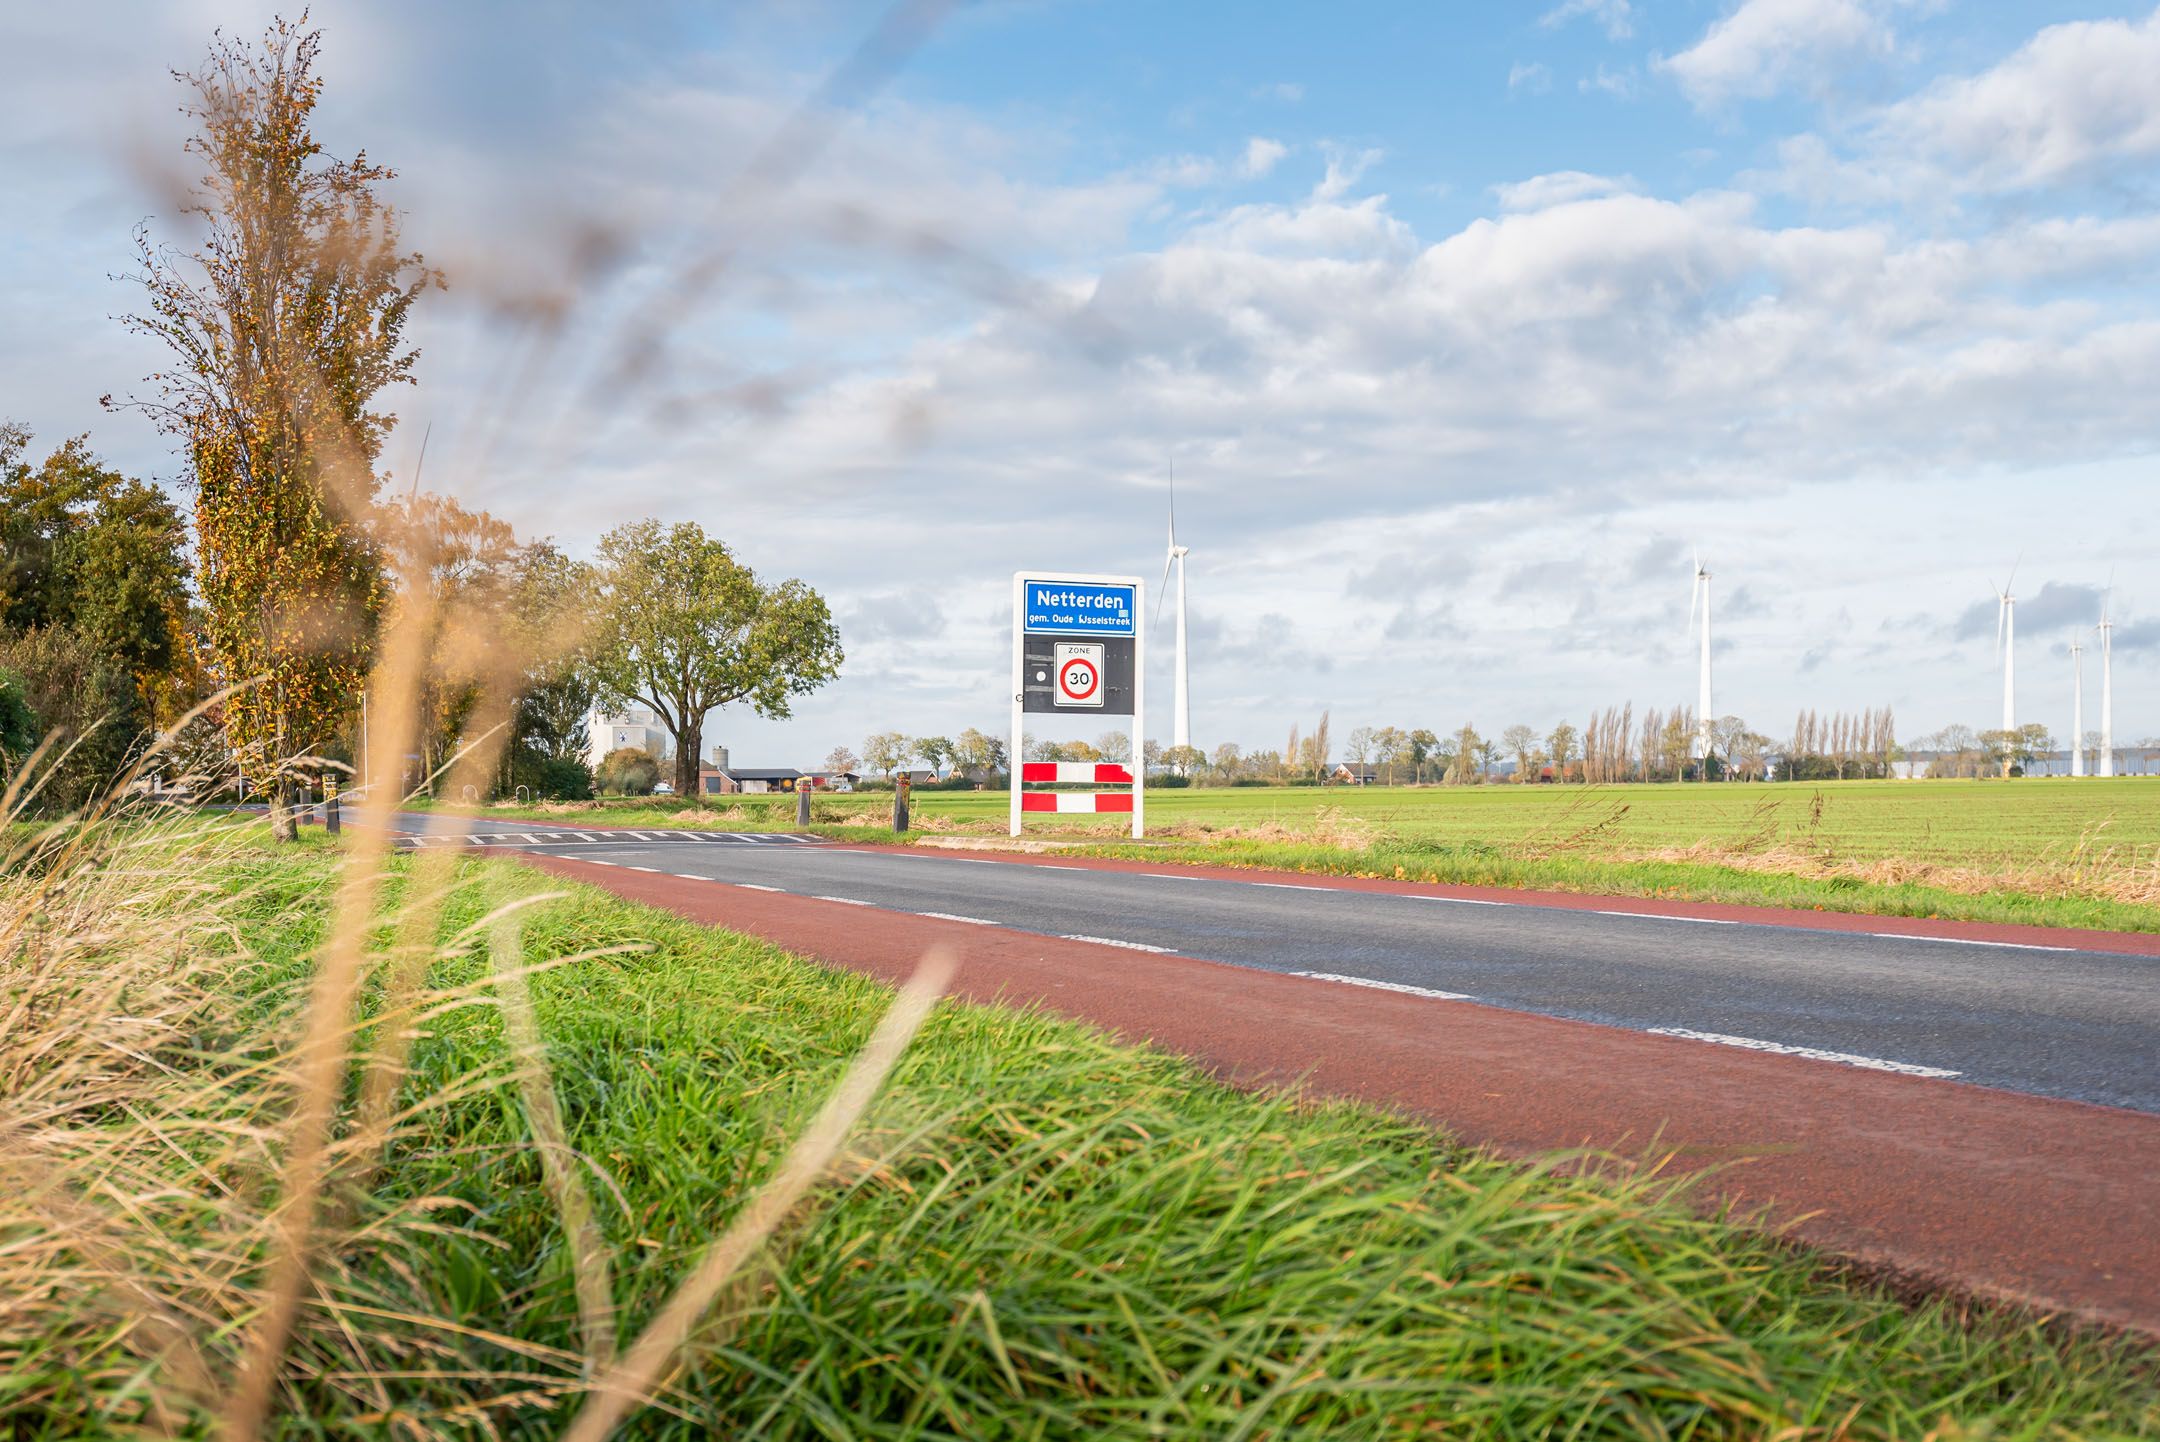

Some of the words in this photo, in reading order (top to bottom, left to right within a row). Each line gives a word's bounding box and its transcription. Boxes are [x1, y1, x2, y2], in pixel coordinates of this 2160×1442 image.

[1037, 590, 1123, 609] Netterden
[1029, 614, 1049, 624] gem.
[1052, 614, 1074, 624] Oude
[1070, 672, 1089, 685] 30
